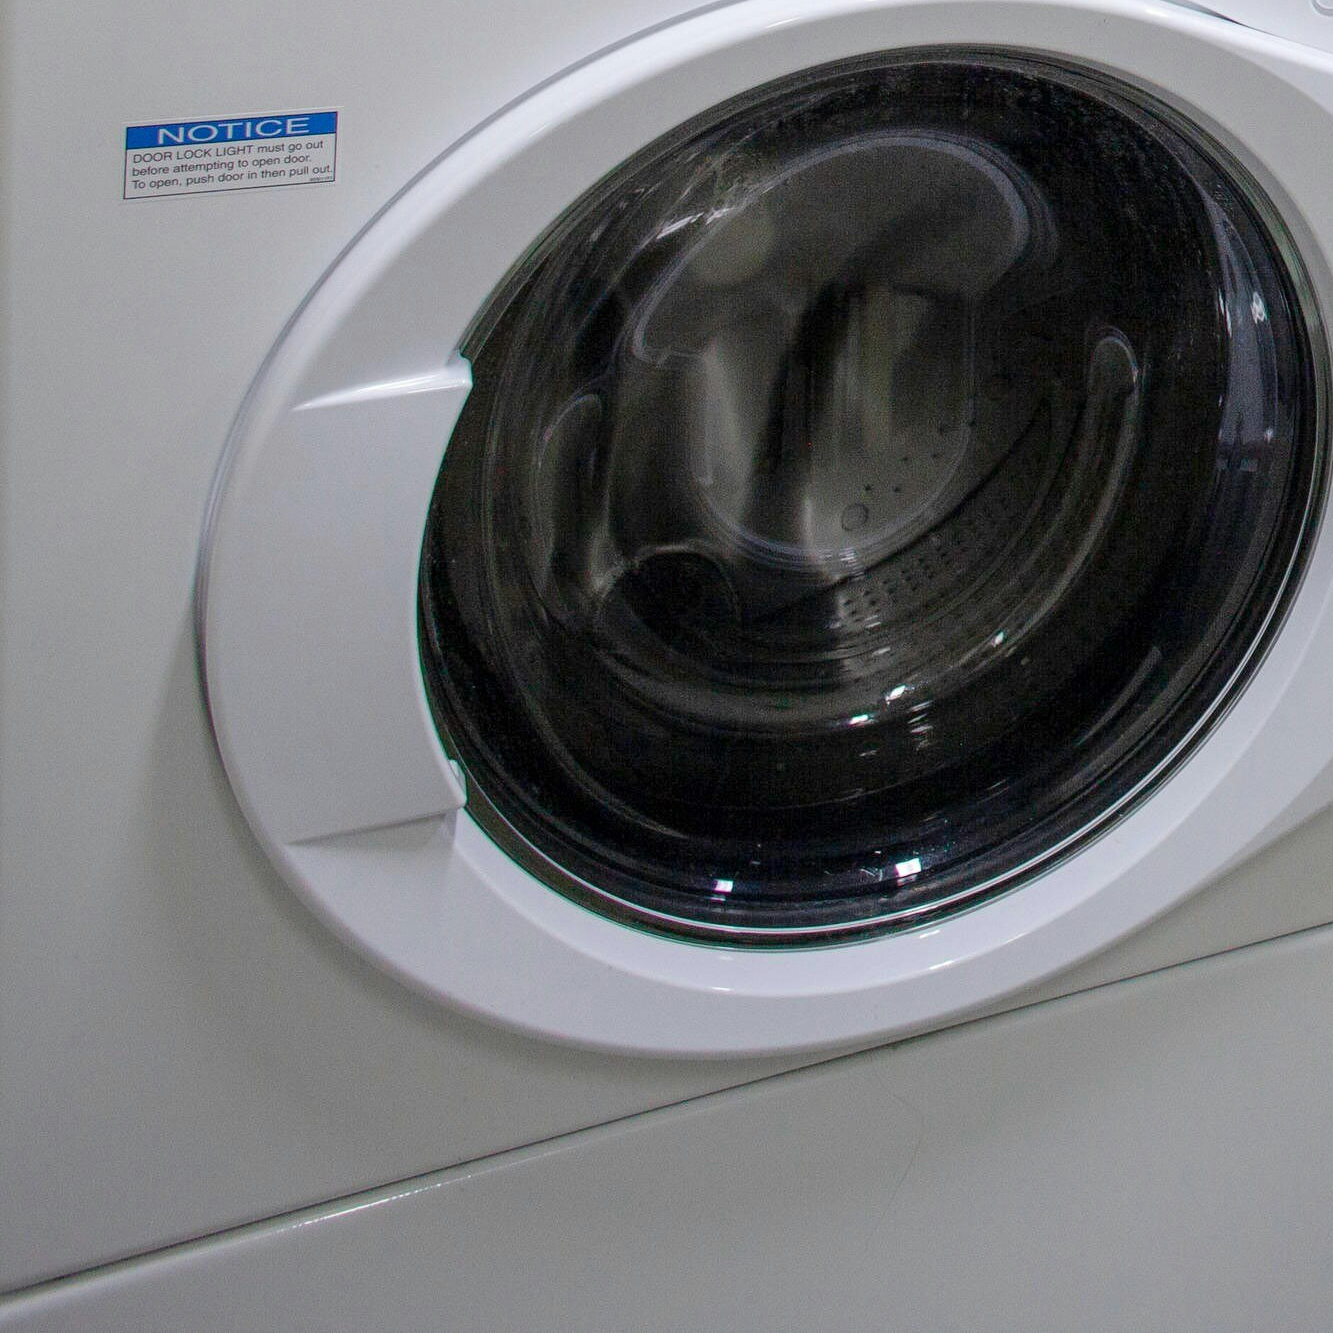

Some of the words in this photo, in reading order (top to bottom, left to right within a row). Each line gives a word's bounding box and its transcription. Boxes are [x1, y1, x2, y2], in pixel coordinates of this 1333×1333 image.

[158, 118, 309, 144] NOTICE
[134, 153, 172, 163] DOOR
[177, 149, 212, 159] LOCK
[216, 146, 253, 156] LIGHT
[258, 144, 285, 153] must
[288, 142, 302, 152] go
[306, 141, 324, 149] out
[133, 166, 169, 176] before
[173, 161, 234, 174] attempting
[238, 159, 248, 168] to
[253, 158, 280, 169] open
[284, 155, 311, 164] door.
[133, 180, 146, 189] To
[149, 179, 182, 189] open,
[187, 174, 214, 186] push
[218, 172, 244, 182] door
[248, 171, 257, 180] in
[262, 168, 286, 178] then
[290, 166, 308, 177] pull
[313, 165, 333, 174] out.
